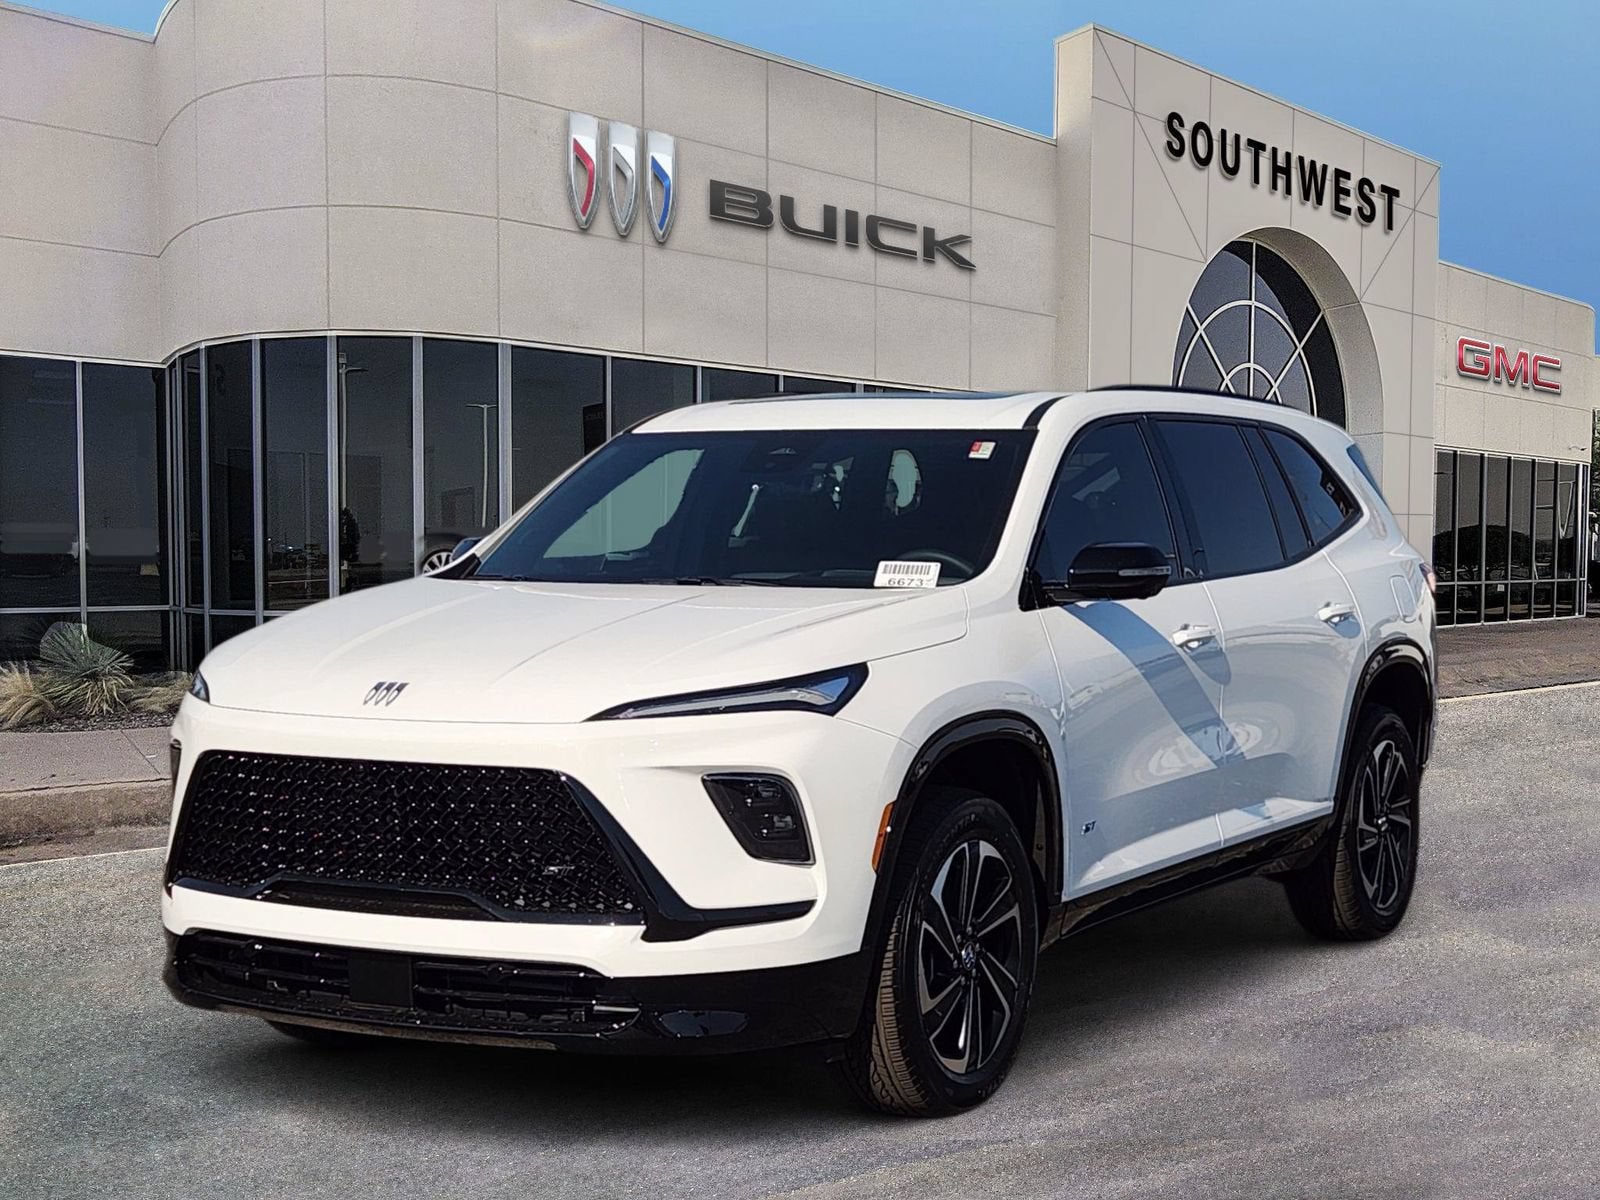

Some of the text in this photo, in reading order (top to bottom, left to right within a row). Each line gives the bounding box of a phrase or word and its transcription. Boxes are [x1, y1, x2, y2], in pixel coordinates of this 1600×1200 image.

[1165, 111, 1400, 231] SOUTHWEST
[709, 178, 977, 270] BUICK
[1457, 335, 1562, 394] GMC
[887, 577, 924, 587] 6673
